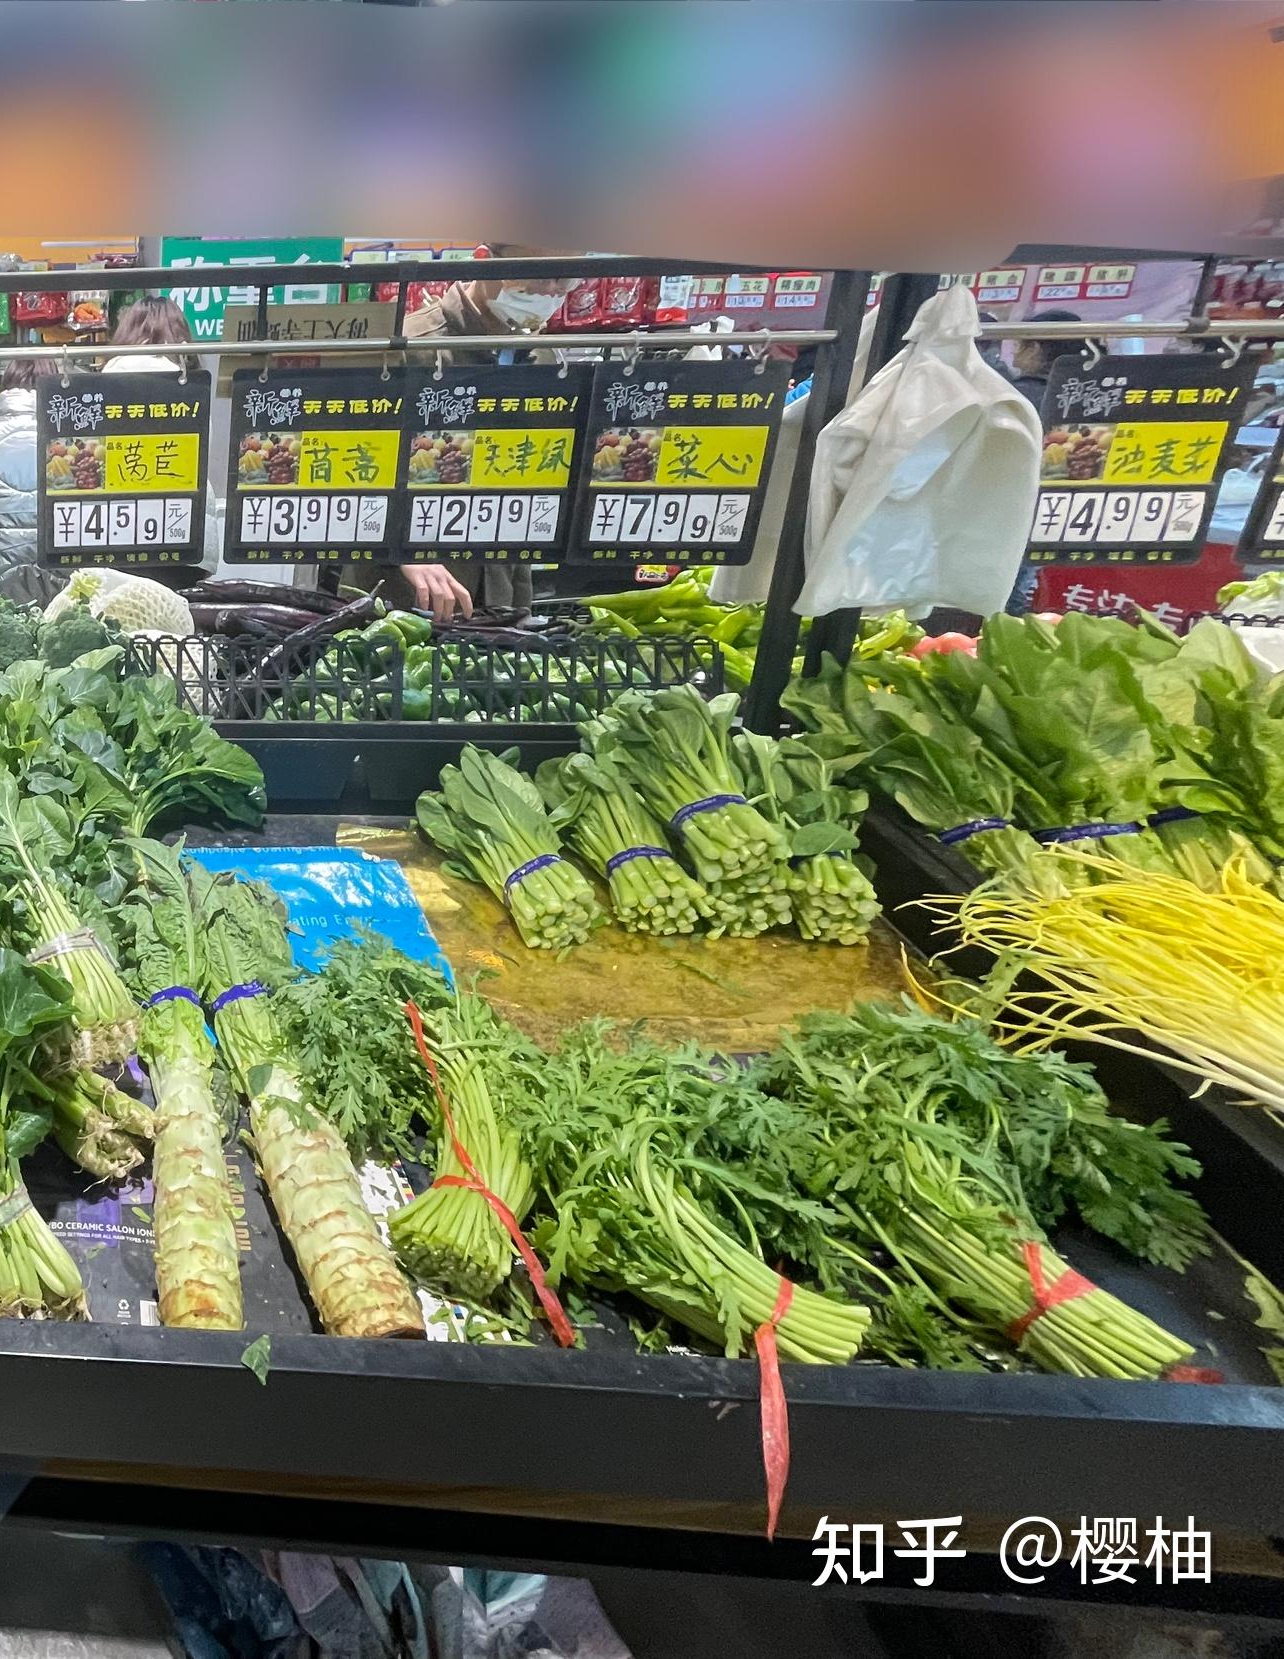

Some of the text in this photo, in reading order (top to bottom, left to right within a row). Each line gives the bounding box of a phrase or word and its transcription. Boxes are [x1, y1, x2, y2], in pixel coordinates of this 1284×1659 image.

[666, 434, 754, 480] 菜心
[66, 1222, 104, 1232] CERAMIC
[106, 1224, 135, 1235] SALON
